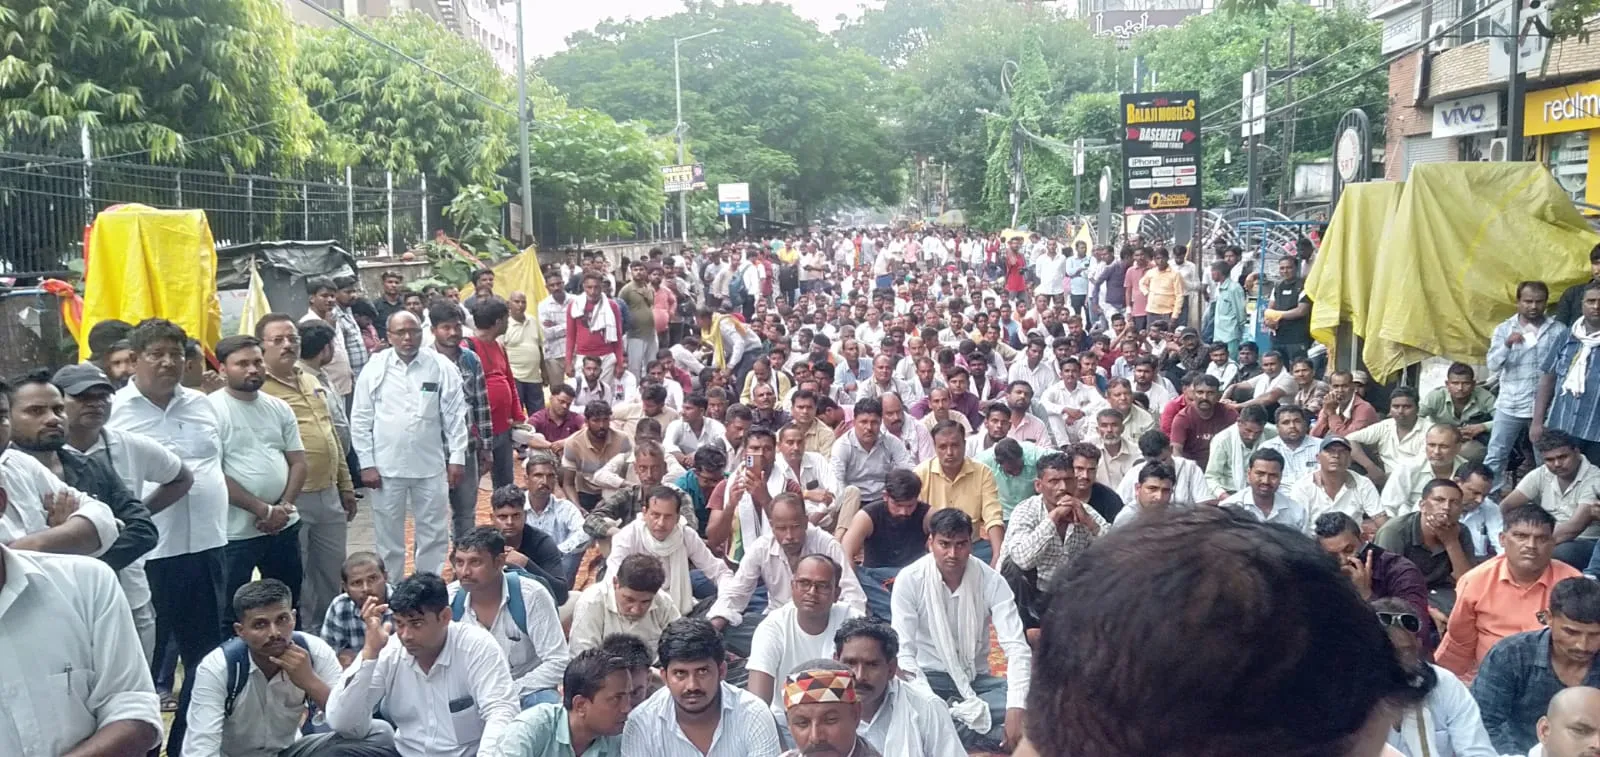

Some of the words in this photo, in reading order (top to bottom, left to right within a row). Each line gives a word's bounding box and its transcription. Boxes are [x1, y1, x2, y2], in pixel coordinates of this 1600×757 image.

[1126, 103, 1158, 124] BALAJI
[1158, 99, 1195, 122] MOBILES
[1441, 101, 1486, 127] vivo
[1543, 92, 1600, 124] realm
[1139, 128, 1183, 141] BASEMENT
[1131, 158, 1160, 166] iPhone
[1340, 158, 1354, 172] SRT
